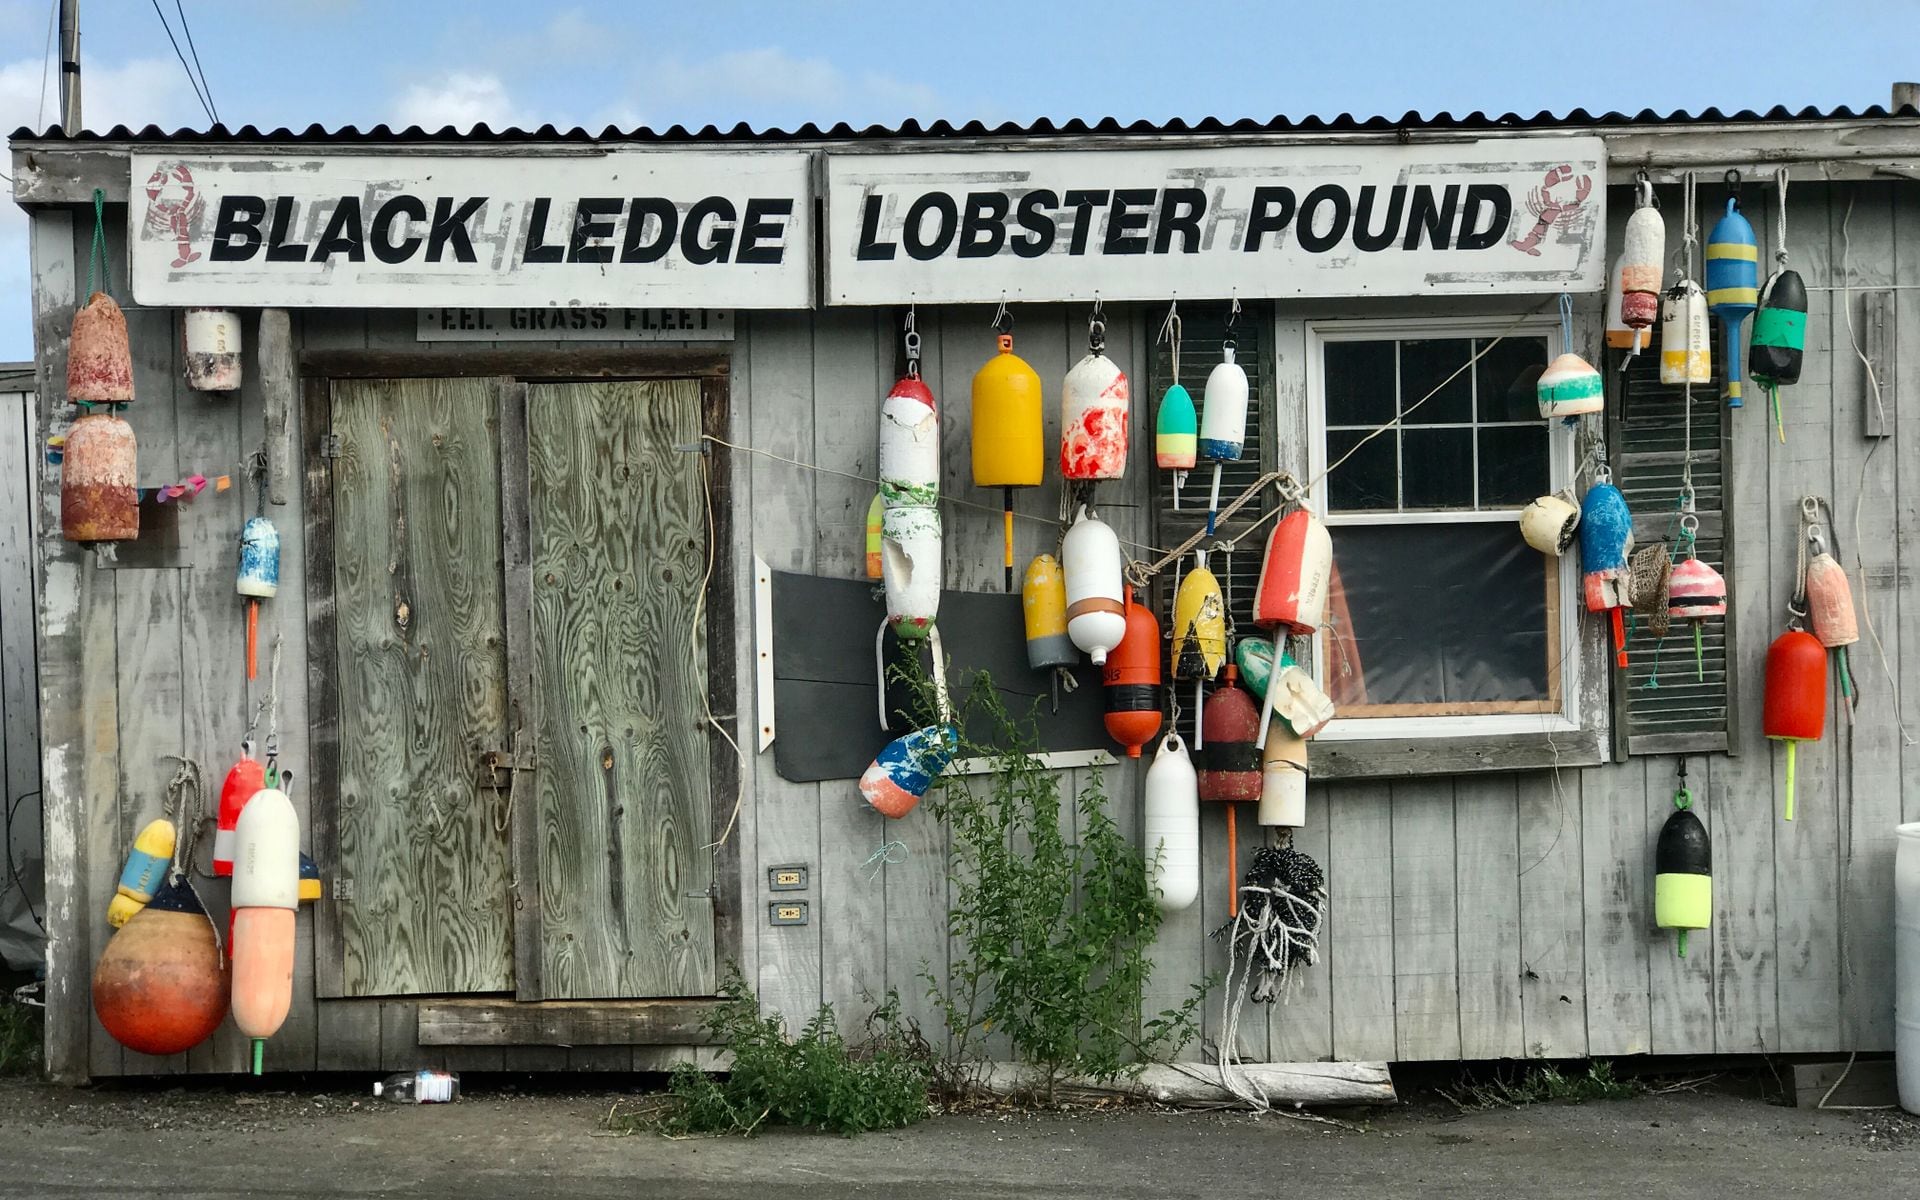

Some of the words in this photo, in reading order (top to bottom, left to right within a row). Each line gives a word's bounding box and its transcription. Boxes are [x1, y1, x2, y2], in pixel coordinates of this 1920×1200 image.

[209, 195, 490, 264] BLACK
[522, 195, 794, 265] LEDGE
[857, 188, 1207, 261] LOBSTER
[1244, 184, 1512, 253] POUND
[441, 308, 494, 330] EEL
[510, 308, 608, 330] GRASS
[624, 308, 708, 330] FLEET
